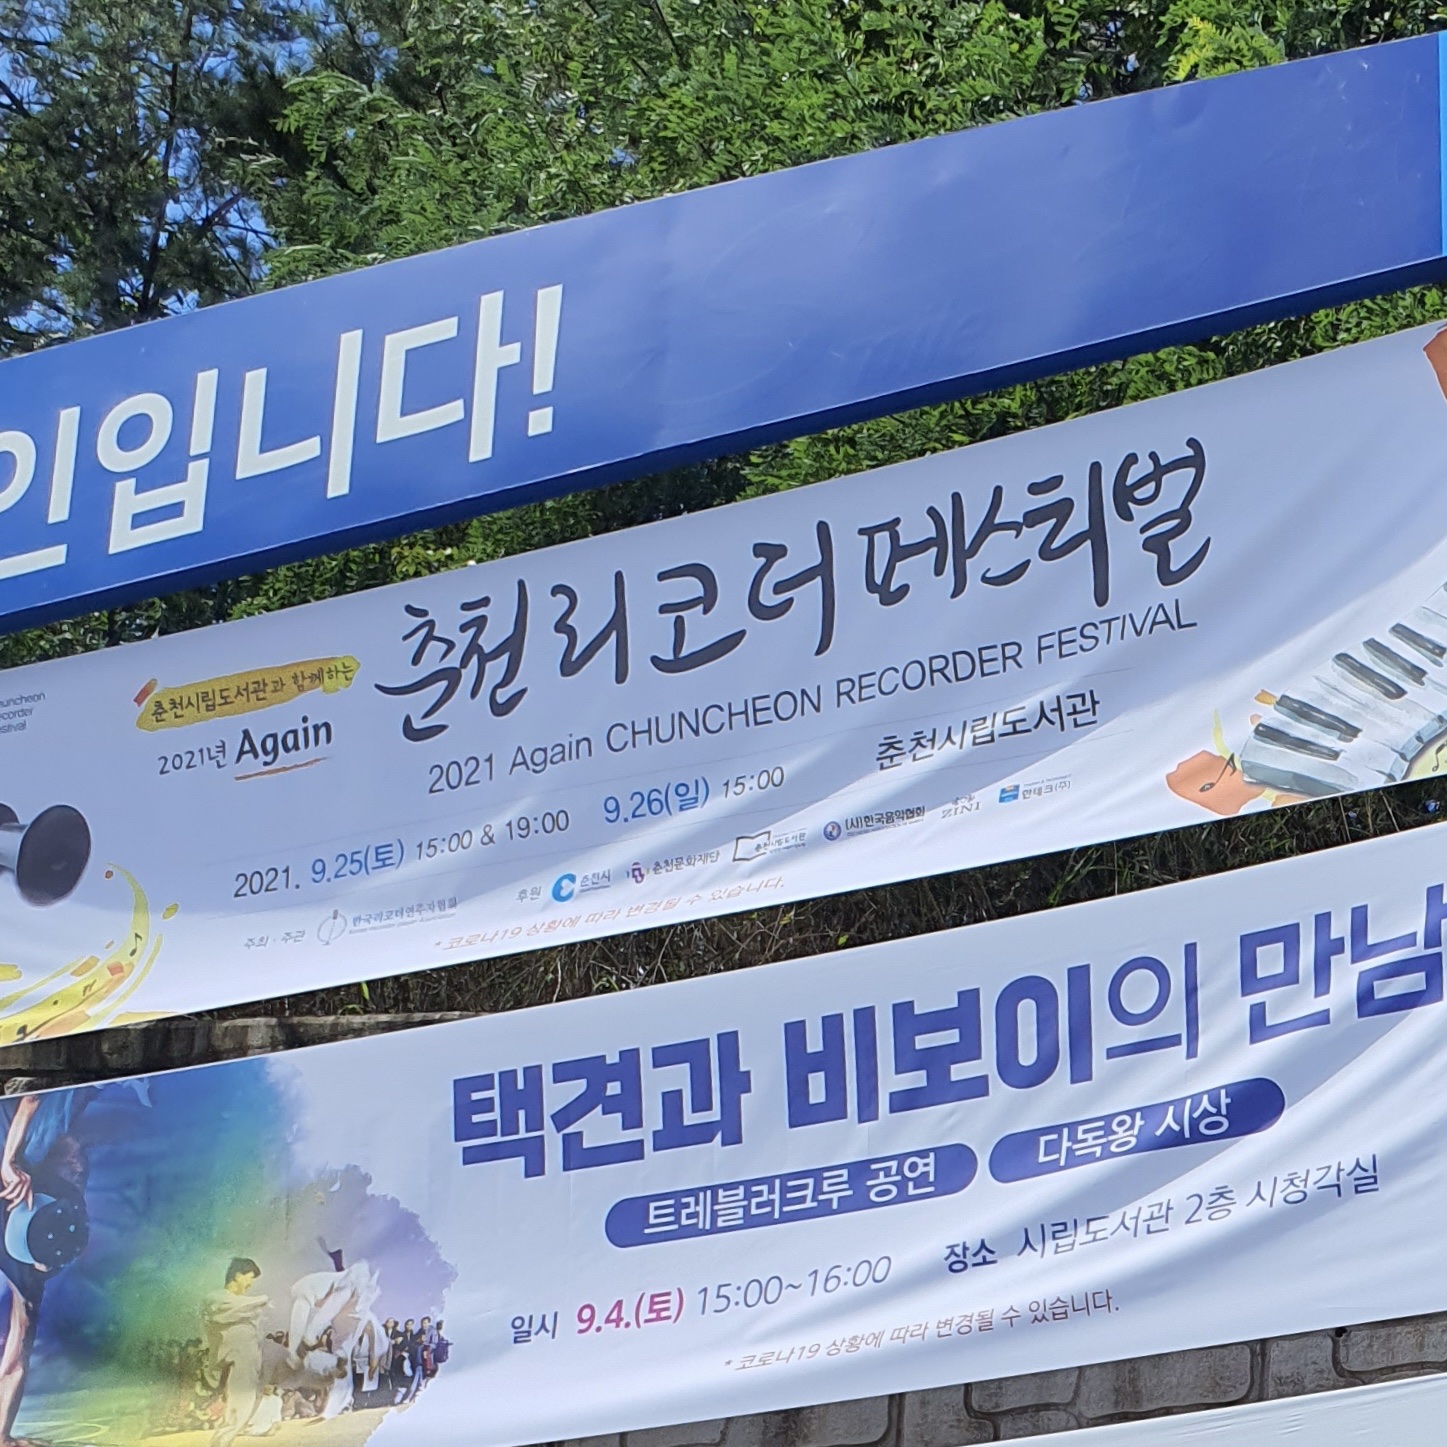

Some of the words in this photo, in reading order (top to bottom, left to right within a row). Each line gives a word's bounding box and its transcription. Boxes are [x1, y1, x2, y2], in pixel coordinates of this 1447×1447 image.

[0, 691, 46, 709] uncheon
[0, 708, 34, 721] corder
[151, 676, 286, 722] 춘천시립도서관과
[292, 662, 355, 693] 함께하는
[429, 756, 496, 794] 2021
[509, 733, 593, 777] Again
[606, 686, 821, 755] CHUNCHEON
[836, 641, 1024, 706] RECORDER
[1037, 599, 1198, 661] FESTIVAL
[875, 689, 1101, 771] 춘천시립도서관
[158, 740, 228, 775] 2021년
[235, 715, 333, 767] Again
[233, 865, 301, 899] 2021.
[310, 838, 406, 885] 9.25(토)
[415, 830, 474, 861] 15:00
[480, 825, 496, 847] &
[506, 809, 570, 841] 19:00
[603, 776, 710, 823] 9.26(일)
[722, 766, 785, 799] 15:00
[941, 800, 982, 819] ZINI
[585, 907, 623, 924] 따라
[625, 895, 680, 918] 변경될
[686, 894, 703, 907] 수
[453, 1029, 752, 1179] 택견과
[784, 941, 1199, 1129] 비보이의
[1036, 1111, 1145, 1167] 다독왕
[1154, 1088, 1232, 1139] 시상
[643, 1167, 854, 1235] 트레블러크루
[865, 1152, 937, 1202] 공연
[943, 1238, 998, 1274] 장소
[1016, 1198, 1176, 1260] 시립도서관
[1184, 1184, 1237, 1226] 2층
[1245, 1152, 1381, 1210] 시청각실
[510, 1310, 559, 1345] 일시
[576, 1286, 685, 1337] 9.4.(토)
[697, 1255, 893, 1316] 15:00~16:00
[734, 1341, 821, 1372] 코로나19
[825, 1328, 887, 1358] 상황에
[890, 1321, 930, 1346] 따라
[935, 1307, 996, 1339] 변경될
[1000, 1303, 1022, 1329] 수
[1027, 1288, 1121, 1326] 있습니다.
